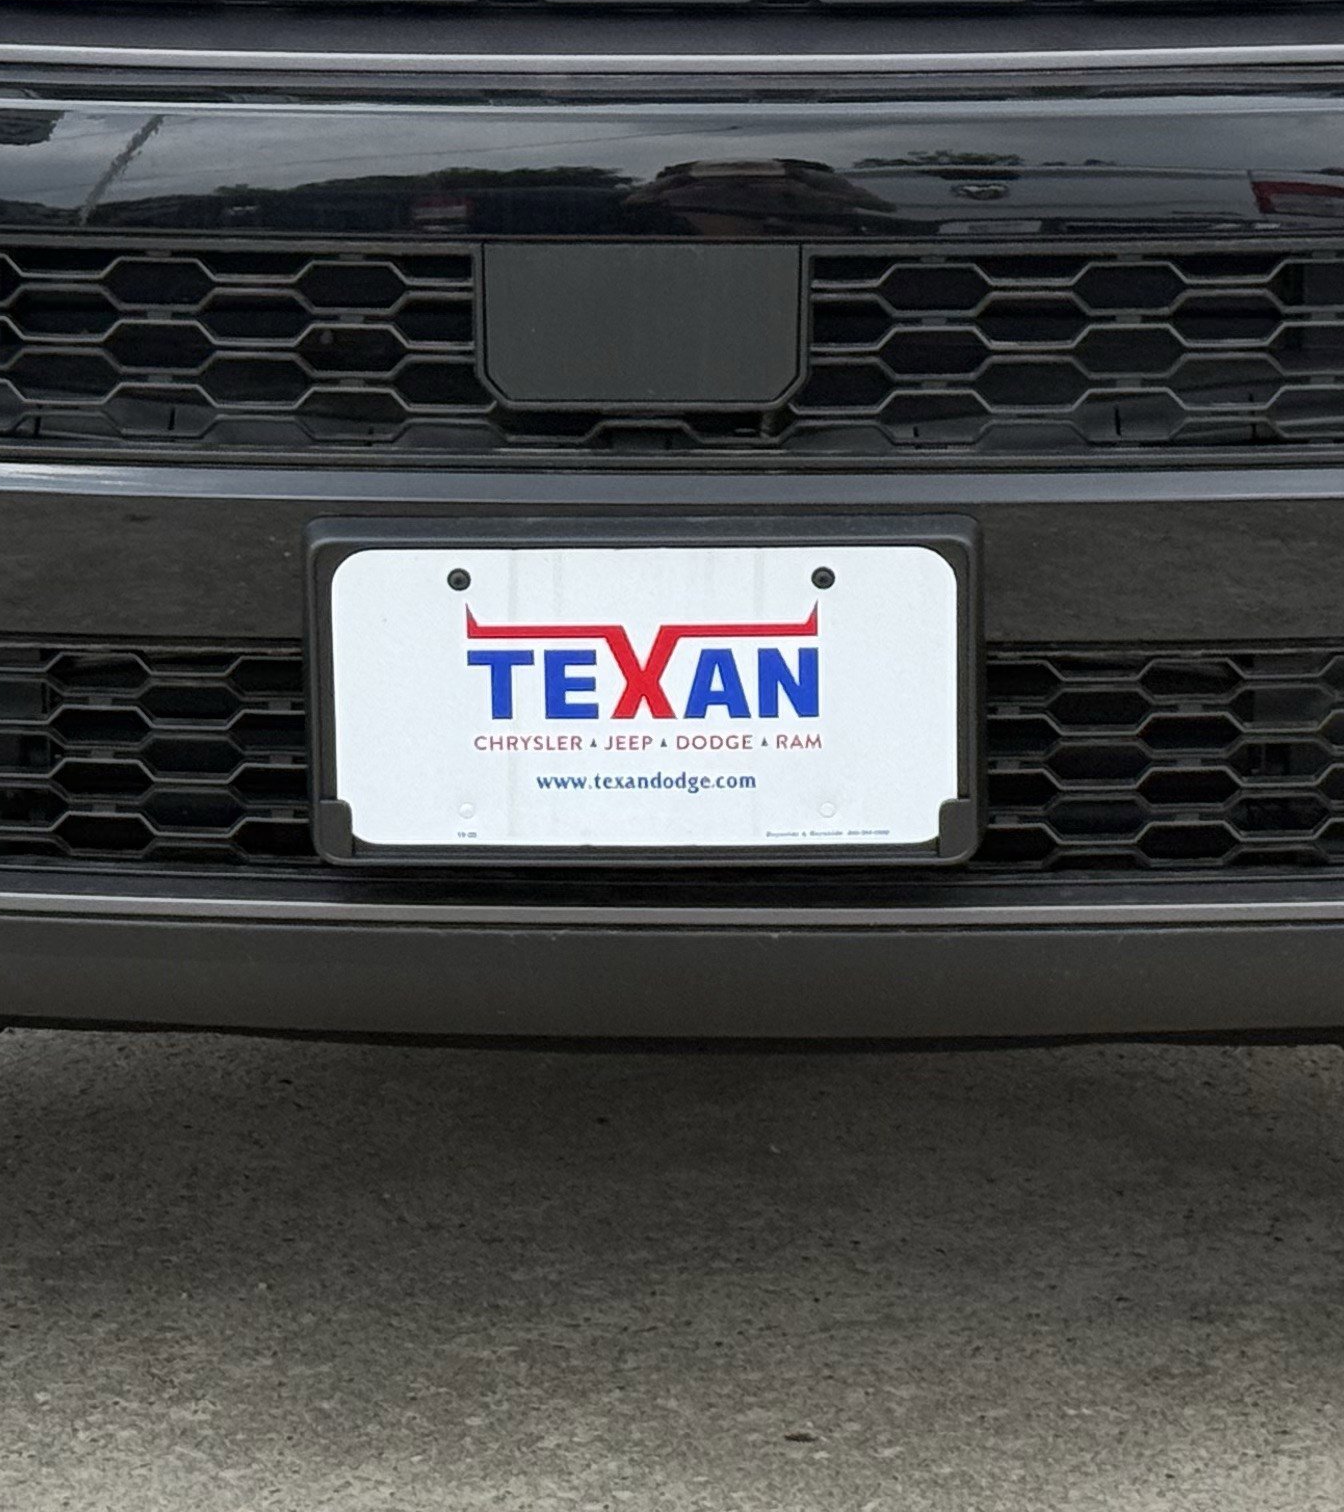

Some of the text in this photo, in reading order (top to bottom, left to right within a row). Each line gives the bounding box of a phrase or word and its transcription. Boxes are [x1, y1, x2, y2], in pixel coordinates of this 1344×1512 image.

[466, 623, 820, 719] TEXAN
[474, 734, 823, 751] CHRYSLER JEEP DODGE RAM
[536, 771, 757, 793] www.texandodge.com
